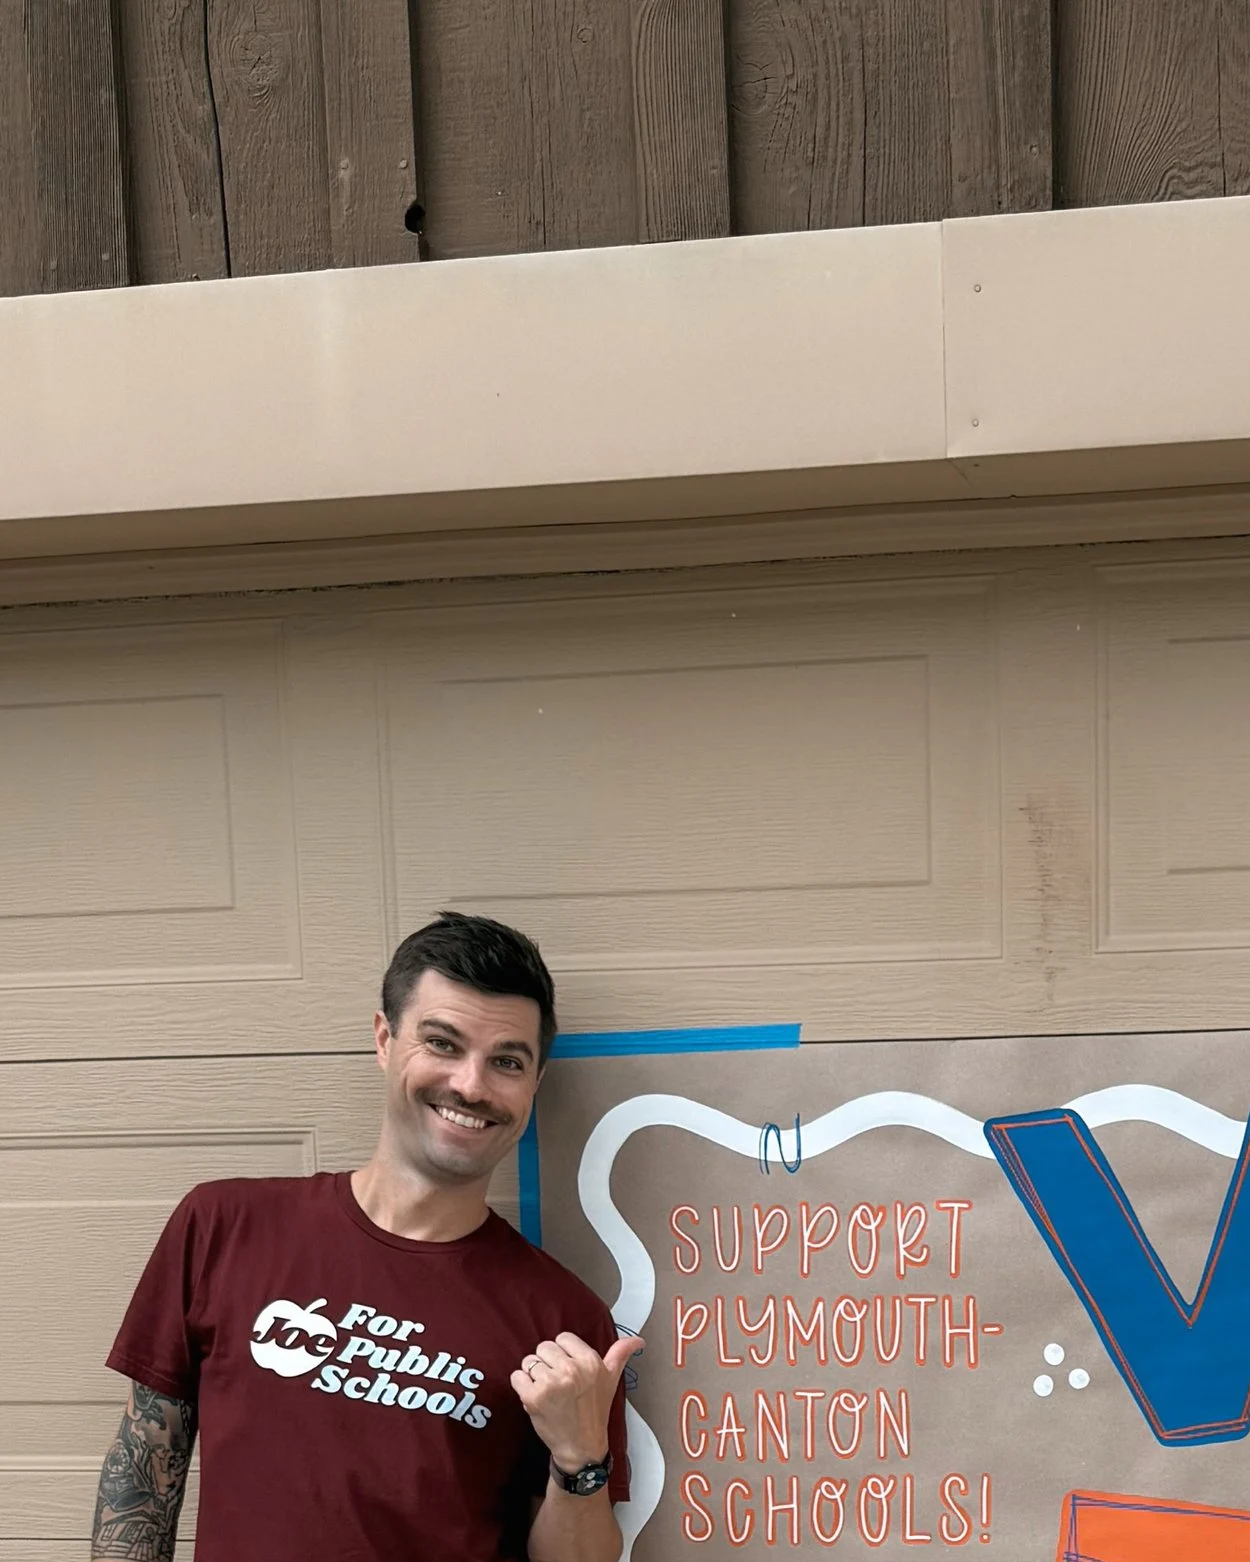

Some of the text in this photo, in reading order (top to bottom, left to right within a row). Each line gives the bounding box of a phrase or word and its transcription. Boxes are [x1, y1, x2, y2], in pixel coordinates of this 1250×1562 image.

[669, 1199, 973, 1279] SUPPORT
[250, 1316, 337, 1357] Joe
[337, 1303, 425, 1342] For
[672, 1294, 1005, 1370] PLYMOUTH-
[310, 1364, 493, 1429] Schools
[336, 1336, 485, 1390] Public
[679, 1388, 912, 1463] CANTON
[680, 1471, 992, 1548] SCHOOLS!
